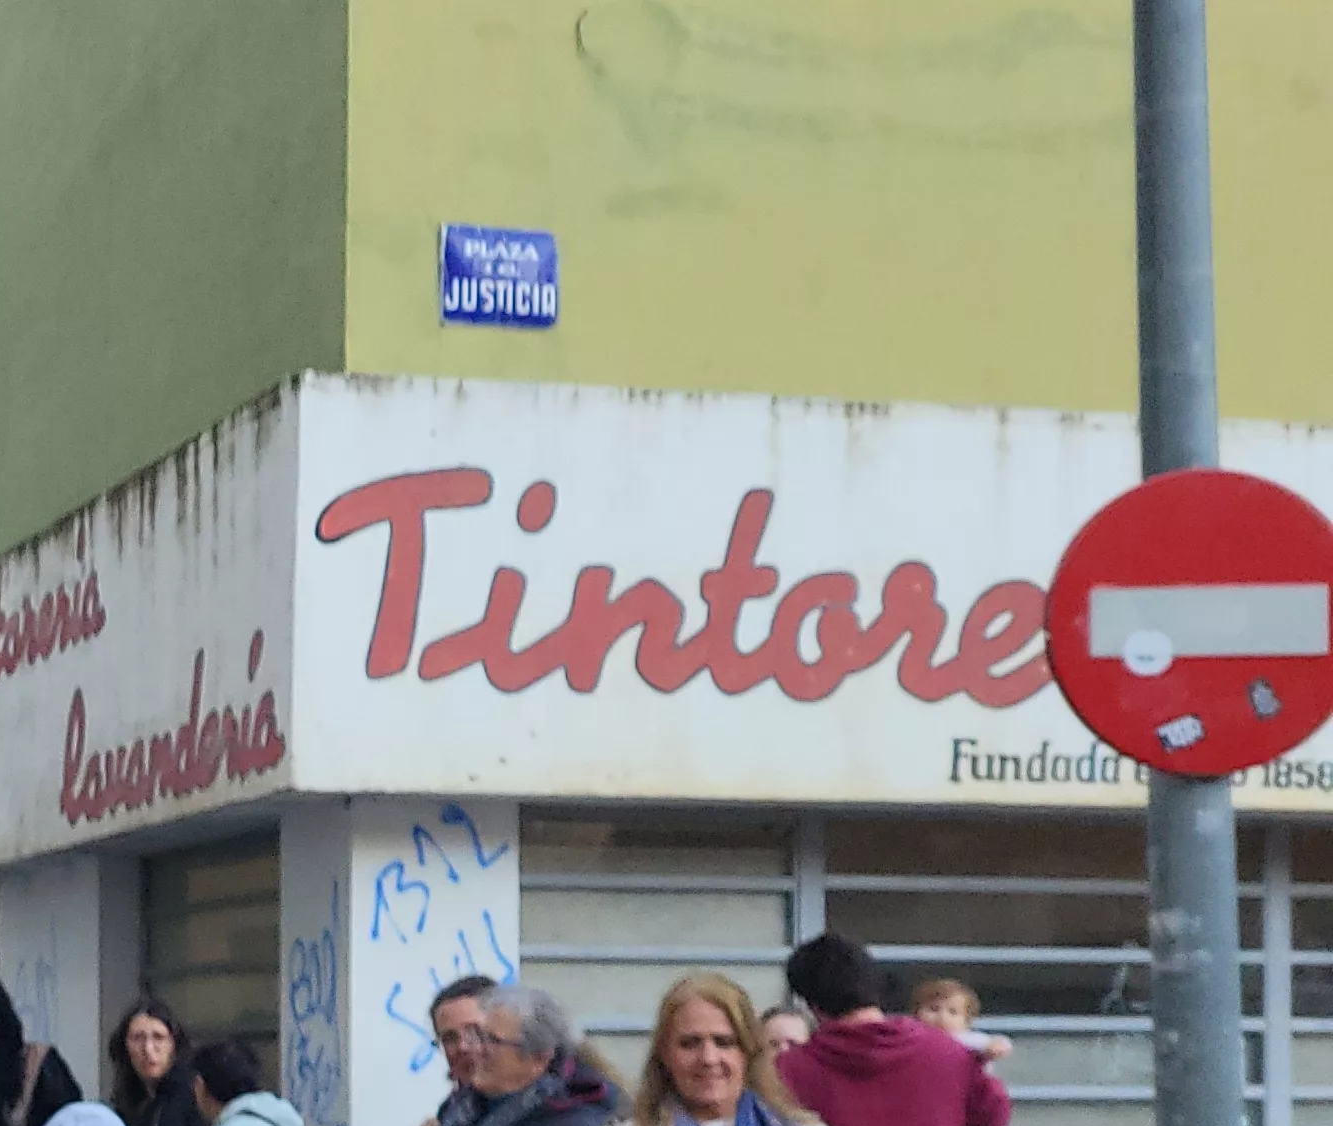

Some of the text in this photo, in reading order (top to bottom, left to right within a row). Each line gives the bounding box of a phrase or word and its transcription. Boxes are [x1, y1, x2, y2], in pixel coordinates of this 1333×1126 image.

[463, 238, 539, 262] PLAZA
[444, 276, 556, 317] JUSTICIA
[949, 736, 1122, 784] Fundada
